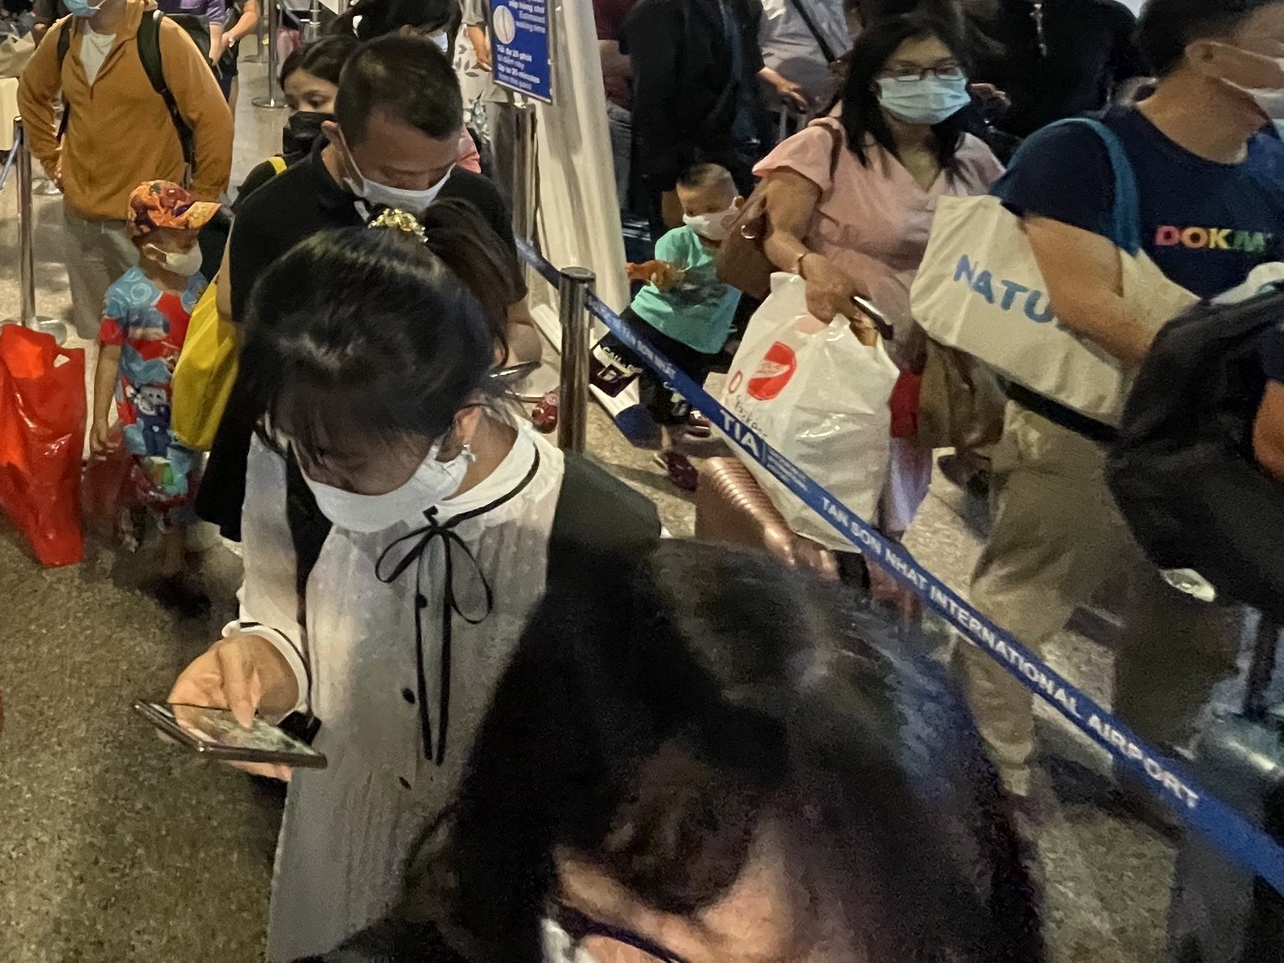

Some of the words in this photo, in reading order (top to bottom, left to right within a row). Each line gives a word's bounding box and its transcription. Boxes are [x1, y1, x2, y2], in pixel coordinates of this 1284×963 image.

[953, 254, 1054, 324] NATU
[719, 409, 760, 459] TIA
[821, 496, 850, 528] TAN
[849, 522, 884, 556] SON
[884, 547, 928, 591] NHAT
[930, 584, 1083, 719] INTERNATIONAL
[1087, 714, 1200, 809] AIRPORT
